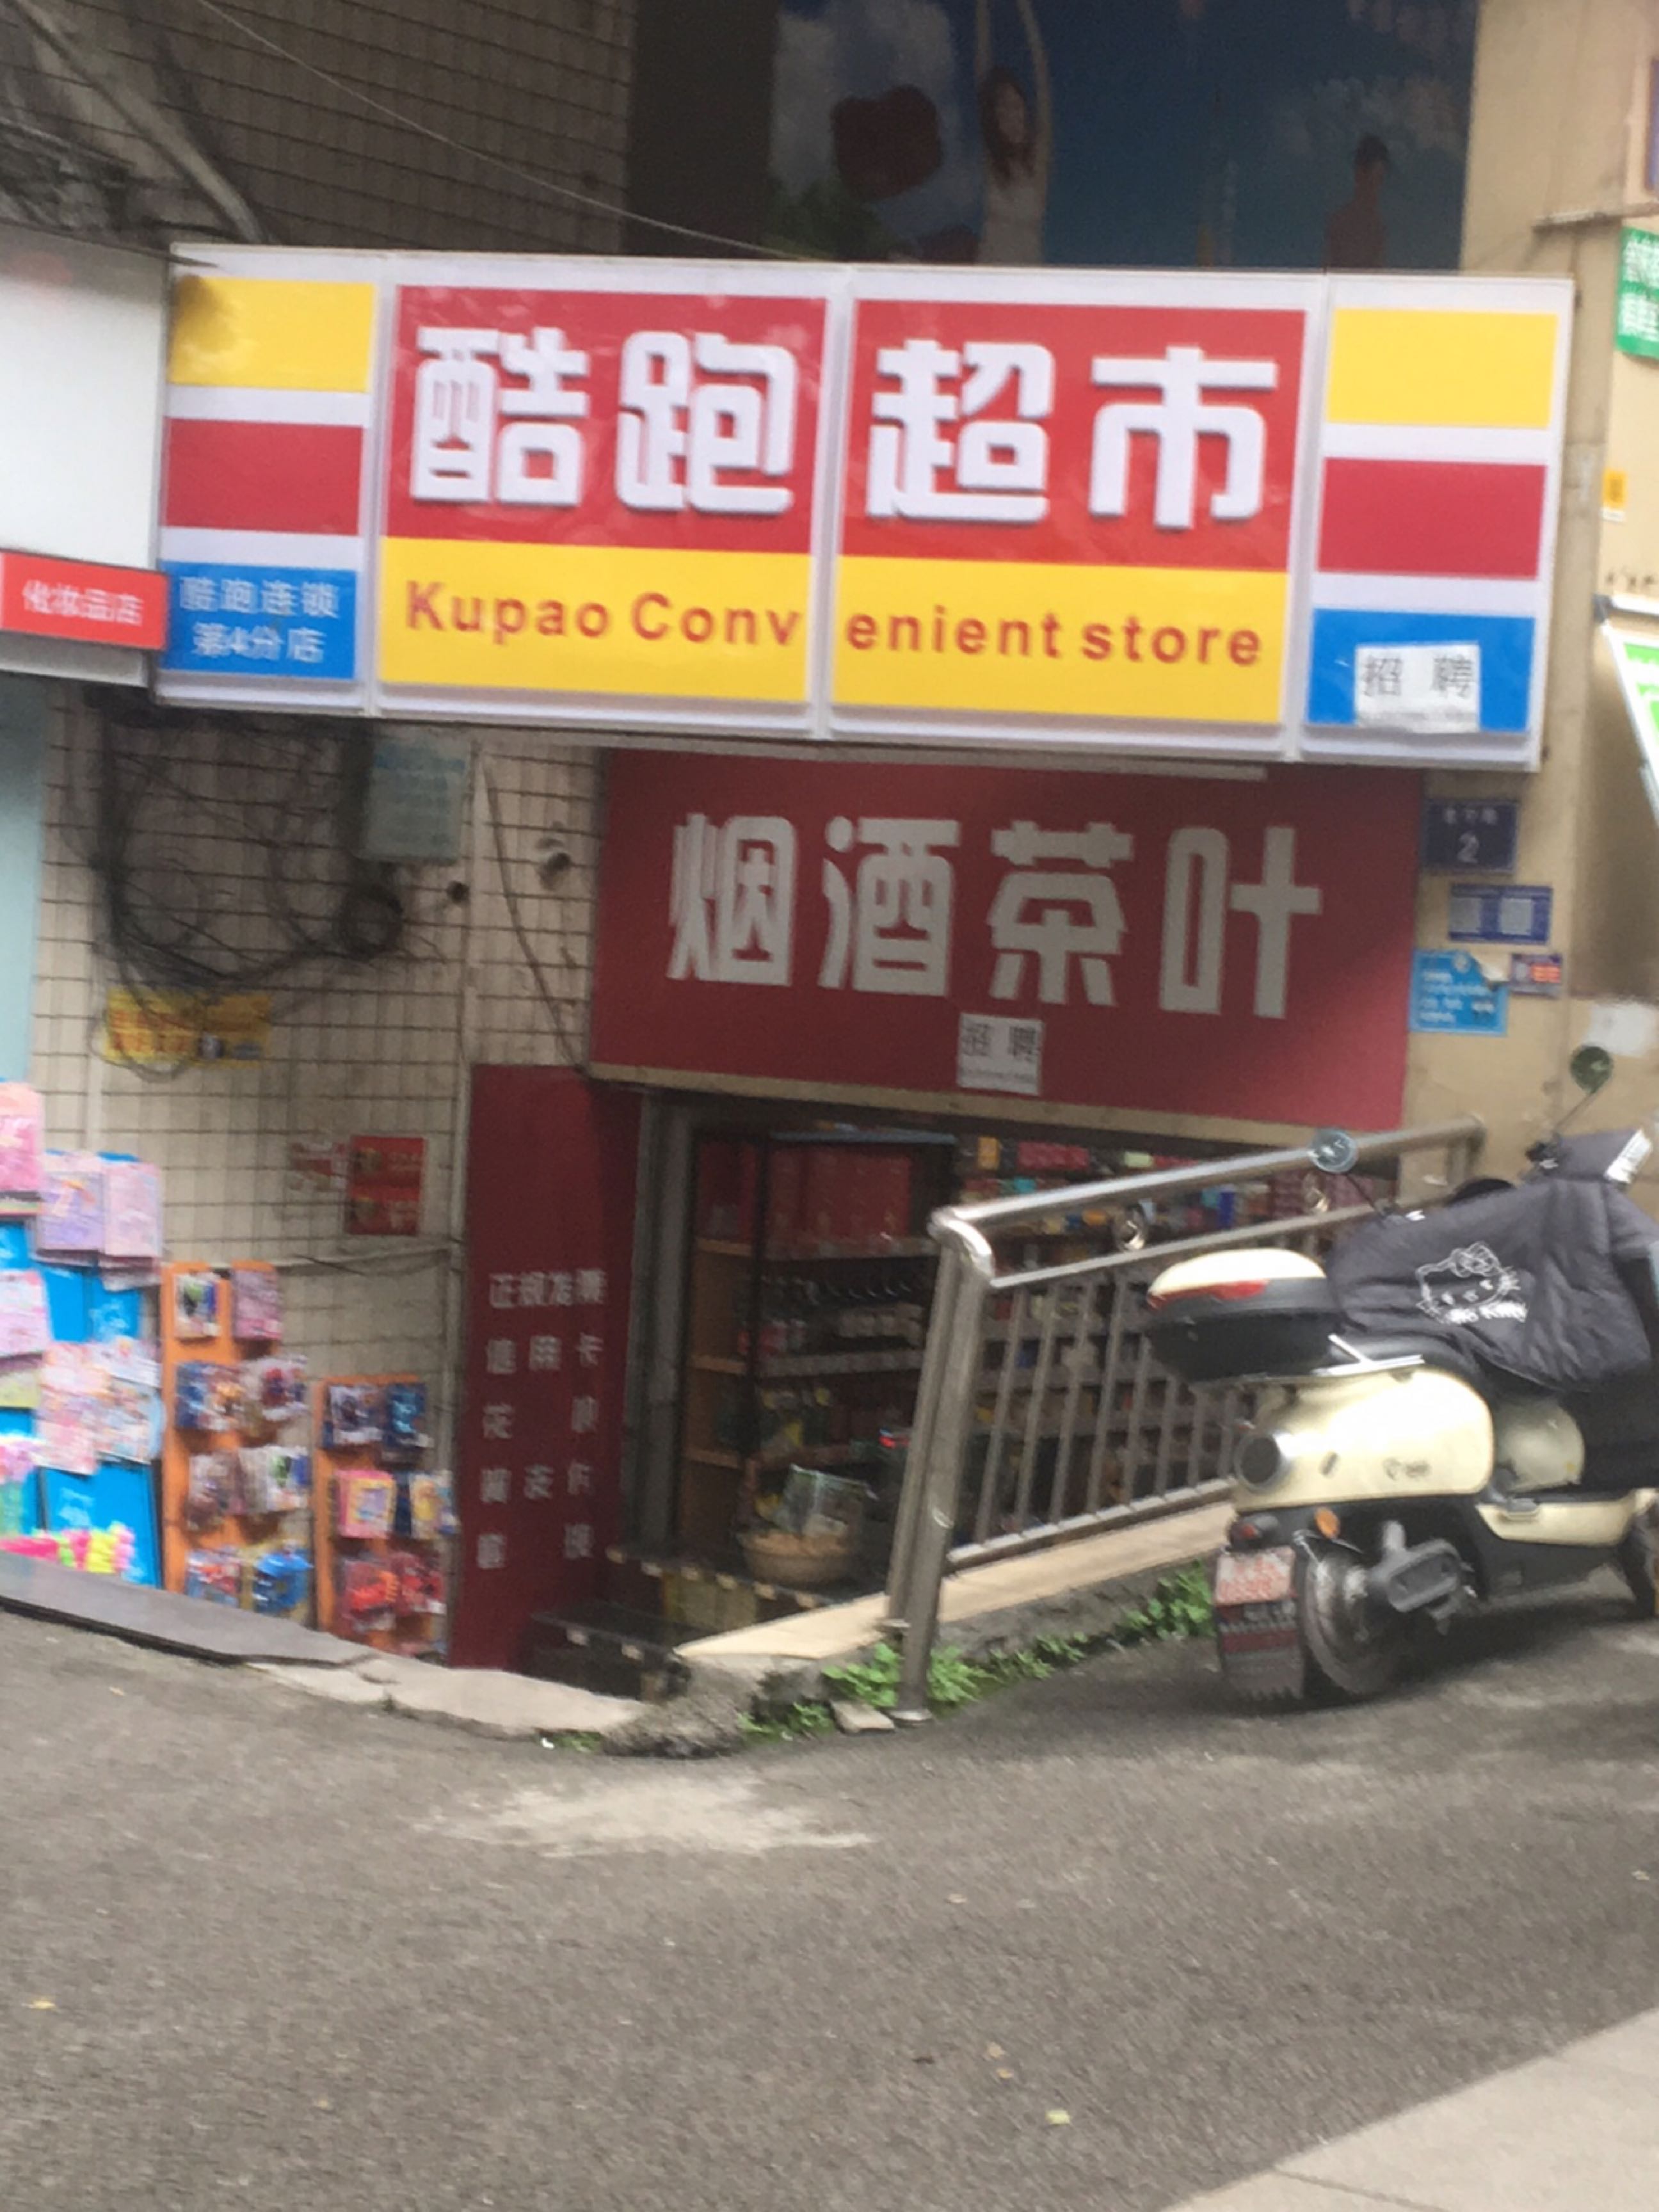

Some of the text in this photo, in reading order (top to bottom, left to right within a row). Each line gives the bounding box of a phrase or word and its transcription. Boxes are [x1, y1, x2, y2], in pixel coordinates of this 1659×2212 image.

[410, 325, 1278, 531] 酷跑超市
[179, 577, 341, 620] 酷跑连锁
[191, 621, 326, 664] 第4分店
[406, 579, 611, 645] Kupao
[1080, 615, 1263, 668] store
[1362, 653, 1475, 698] 招聘
[1457, 831, 1480, 863] 2
[666, 812, 1322, 1020] 烟酒茶叶
